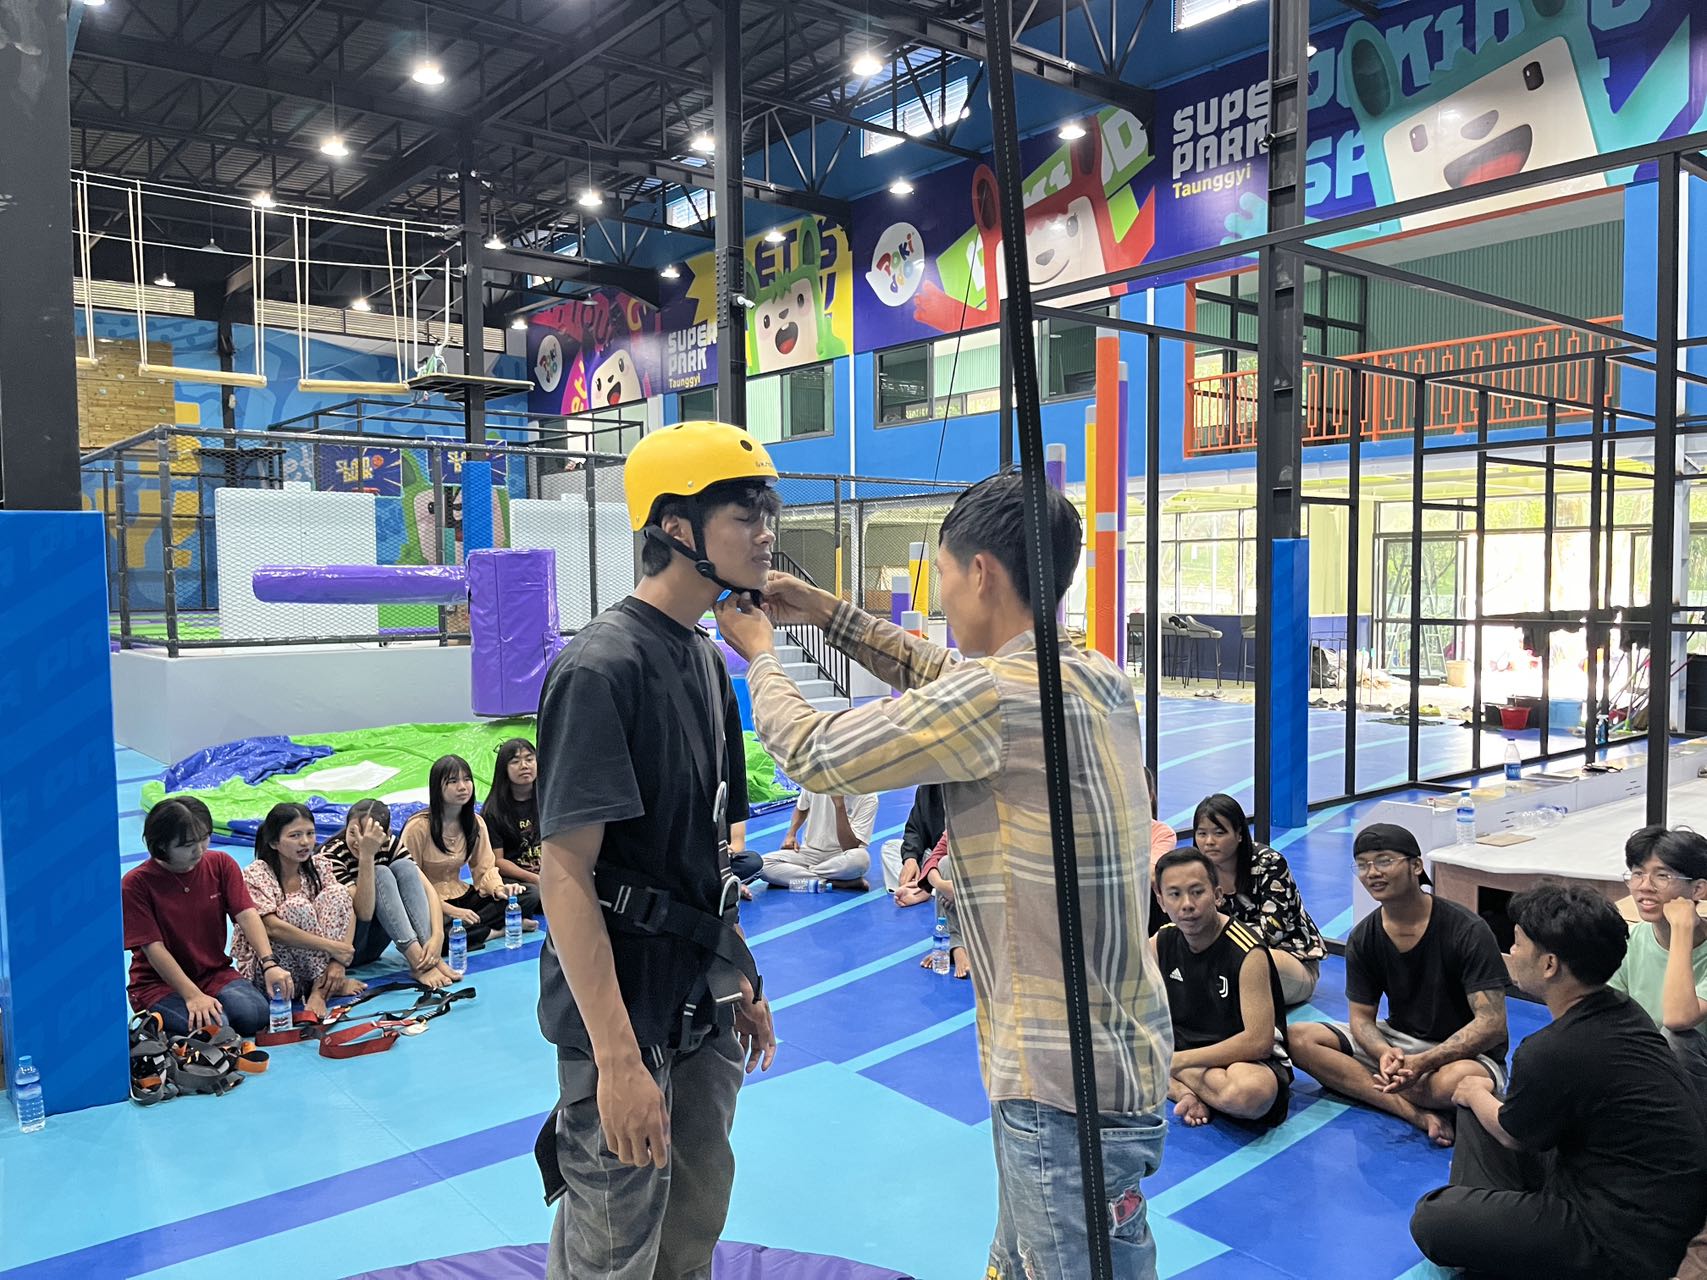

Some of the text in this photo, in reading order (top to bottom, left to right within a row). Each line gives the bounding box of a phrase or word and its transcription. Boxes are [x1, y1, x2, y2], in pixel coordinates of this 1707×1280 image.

[1172, 79, 1270, 145] SUPE
[1172, 118, 1270, 181] PARK
[1172, 162, 1252, 199] Taunggyi
[667, 320, 718, 354] SUPER
[668, 346, 707, 377] PARK
[668, 372, 701, 389] Taunggyi
